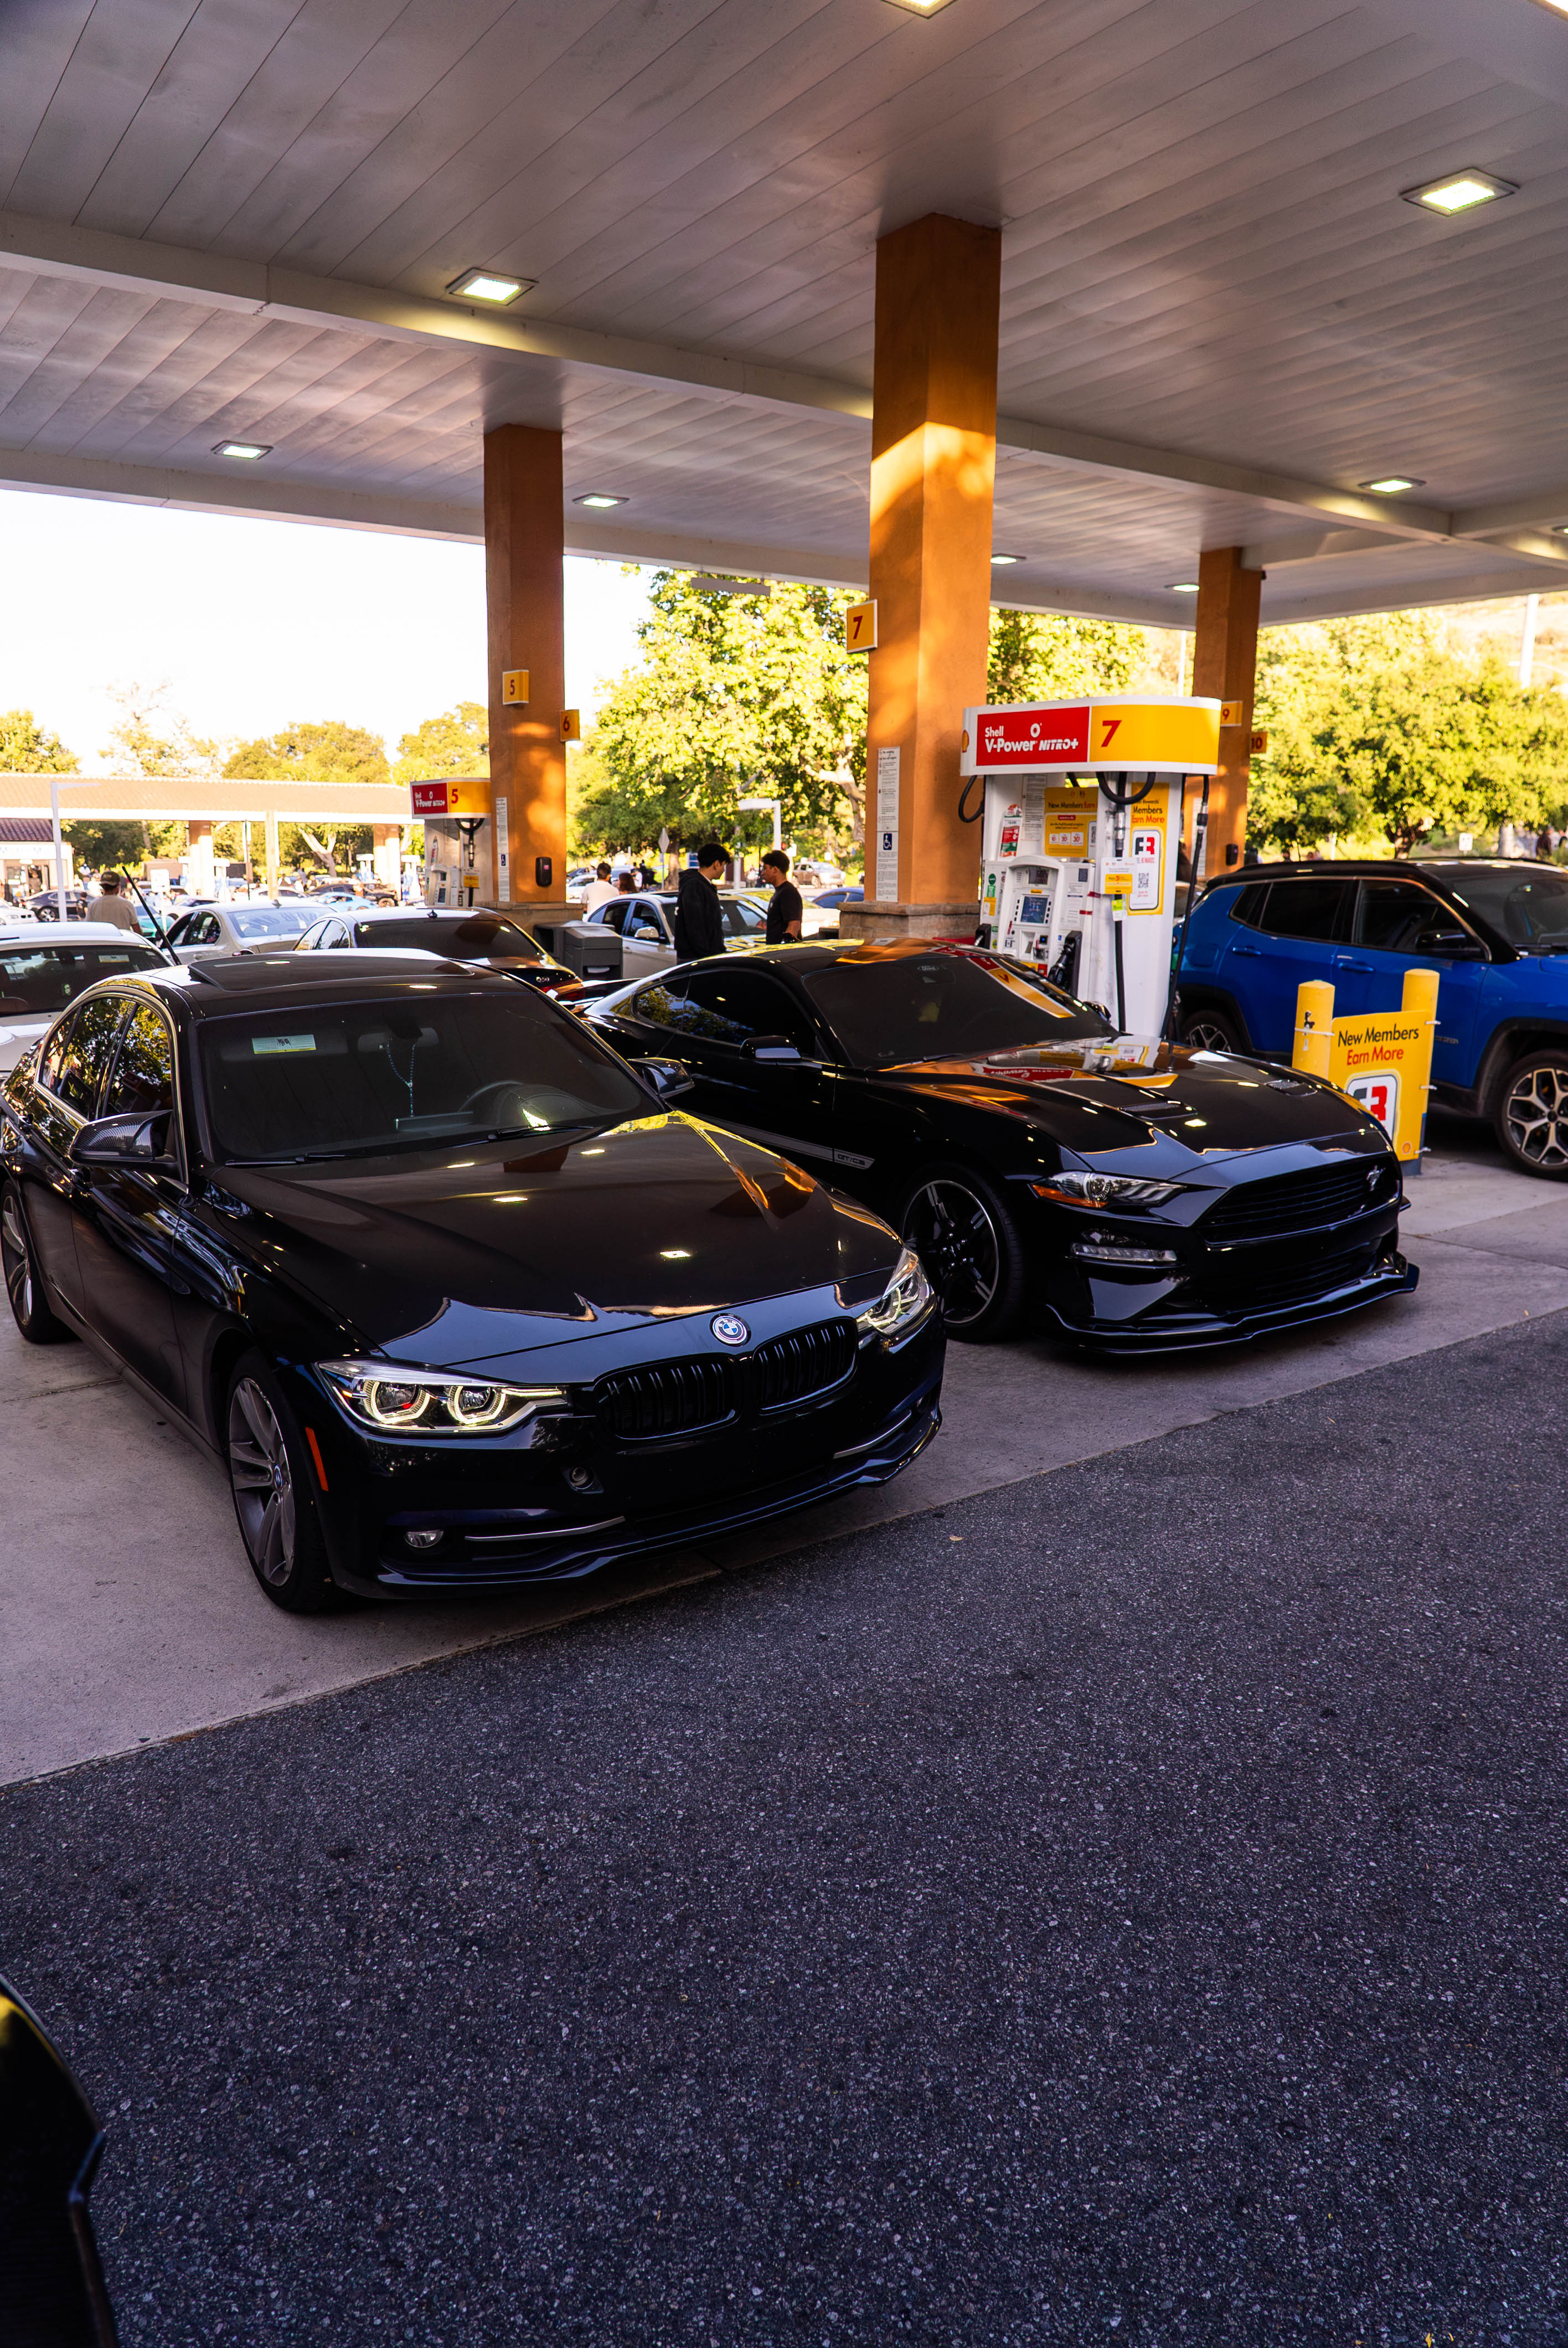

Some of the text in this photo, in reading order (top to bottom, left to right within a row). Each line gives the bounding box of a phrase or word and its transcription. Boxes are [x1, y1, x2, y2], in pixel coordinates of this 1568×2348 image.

[853, 615, 863, 640] 7
[509, 679, 515, 696] 5
[1223, 708, 1230, 720] 9
[563, 715, 570, 732] 6
[985, 725, 1004, 738] Shell
[1101, 720, 1122, 747] 7
[985, 738, 1036, 753] V-Power
[451, 789, 458, 804] 5
[1133, 804, 1163, 815] Members
[1146, 815, 1165, 824] More
[1338, 1030, 1363, 1048] New
[1364, 1023, 1419, 1043] Members
[1347, 1046, 1404, 1065] Earn More
[718, 1319, 737, 1327] BMW
